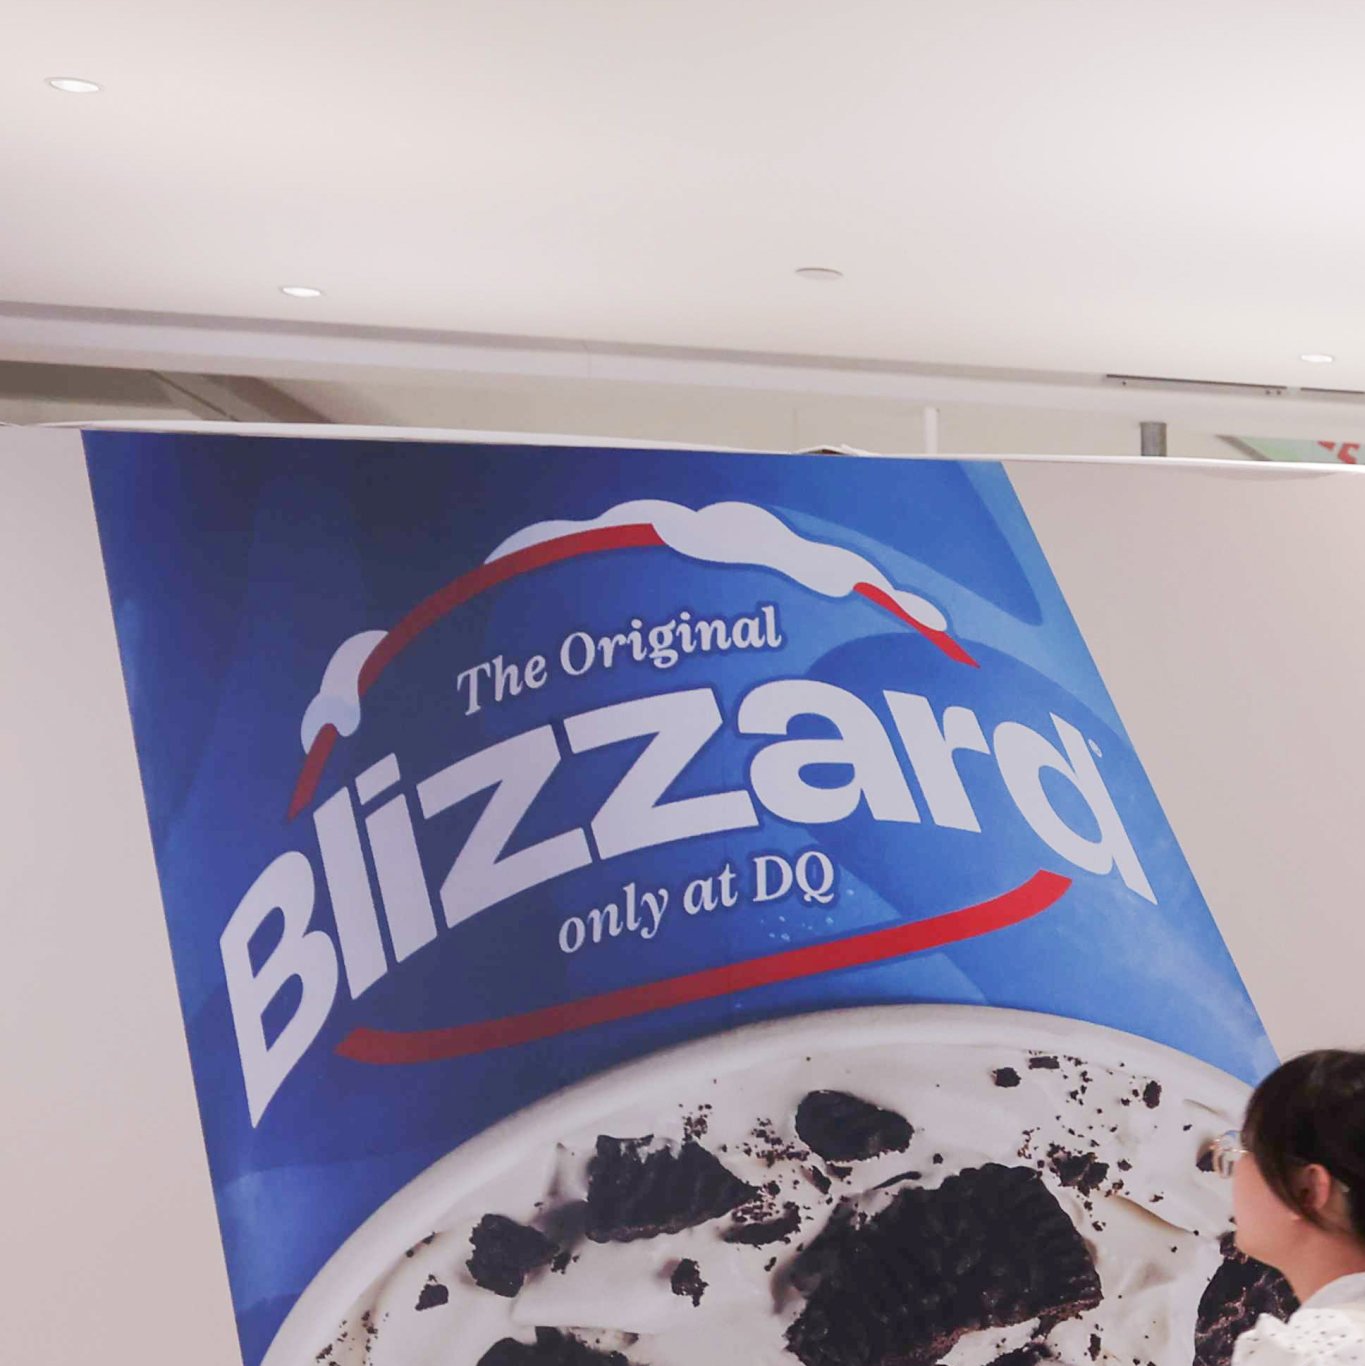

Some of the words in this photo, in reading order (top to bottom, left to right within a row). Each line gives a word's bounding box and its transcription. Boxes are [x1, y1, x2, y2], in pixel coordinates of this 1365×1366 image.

[456, 652, 549, 716] The
[559, 604, 783, 675] Original
[218, 678, 1159, 1130] Blizzard
[557, 881, 672, 955] only
[682, 863, 738, 917] at
[751, 850, 836, 905] DQ
